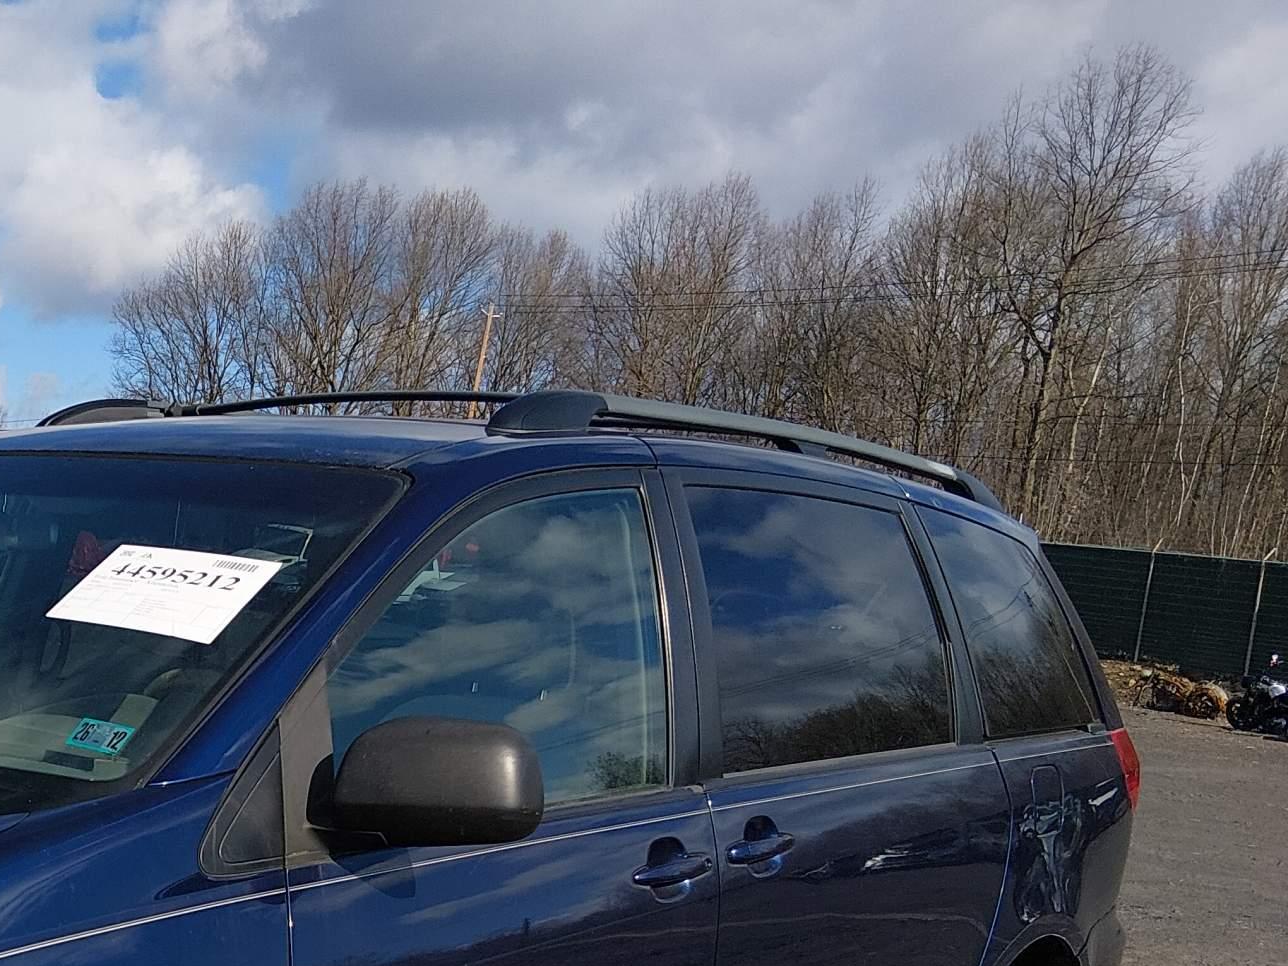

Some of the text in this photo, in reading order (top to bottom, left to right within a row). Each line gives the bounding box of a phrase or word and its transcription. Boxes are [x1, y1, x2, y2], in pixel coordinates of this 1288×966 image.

[112, 562, 241, 591] 44595212
[73, 722, 128, 751] 26 12
